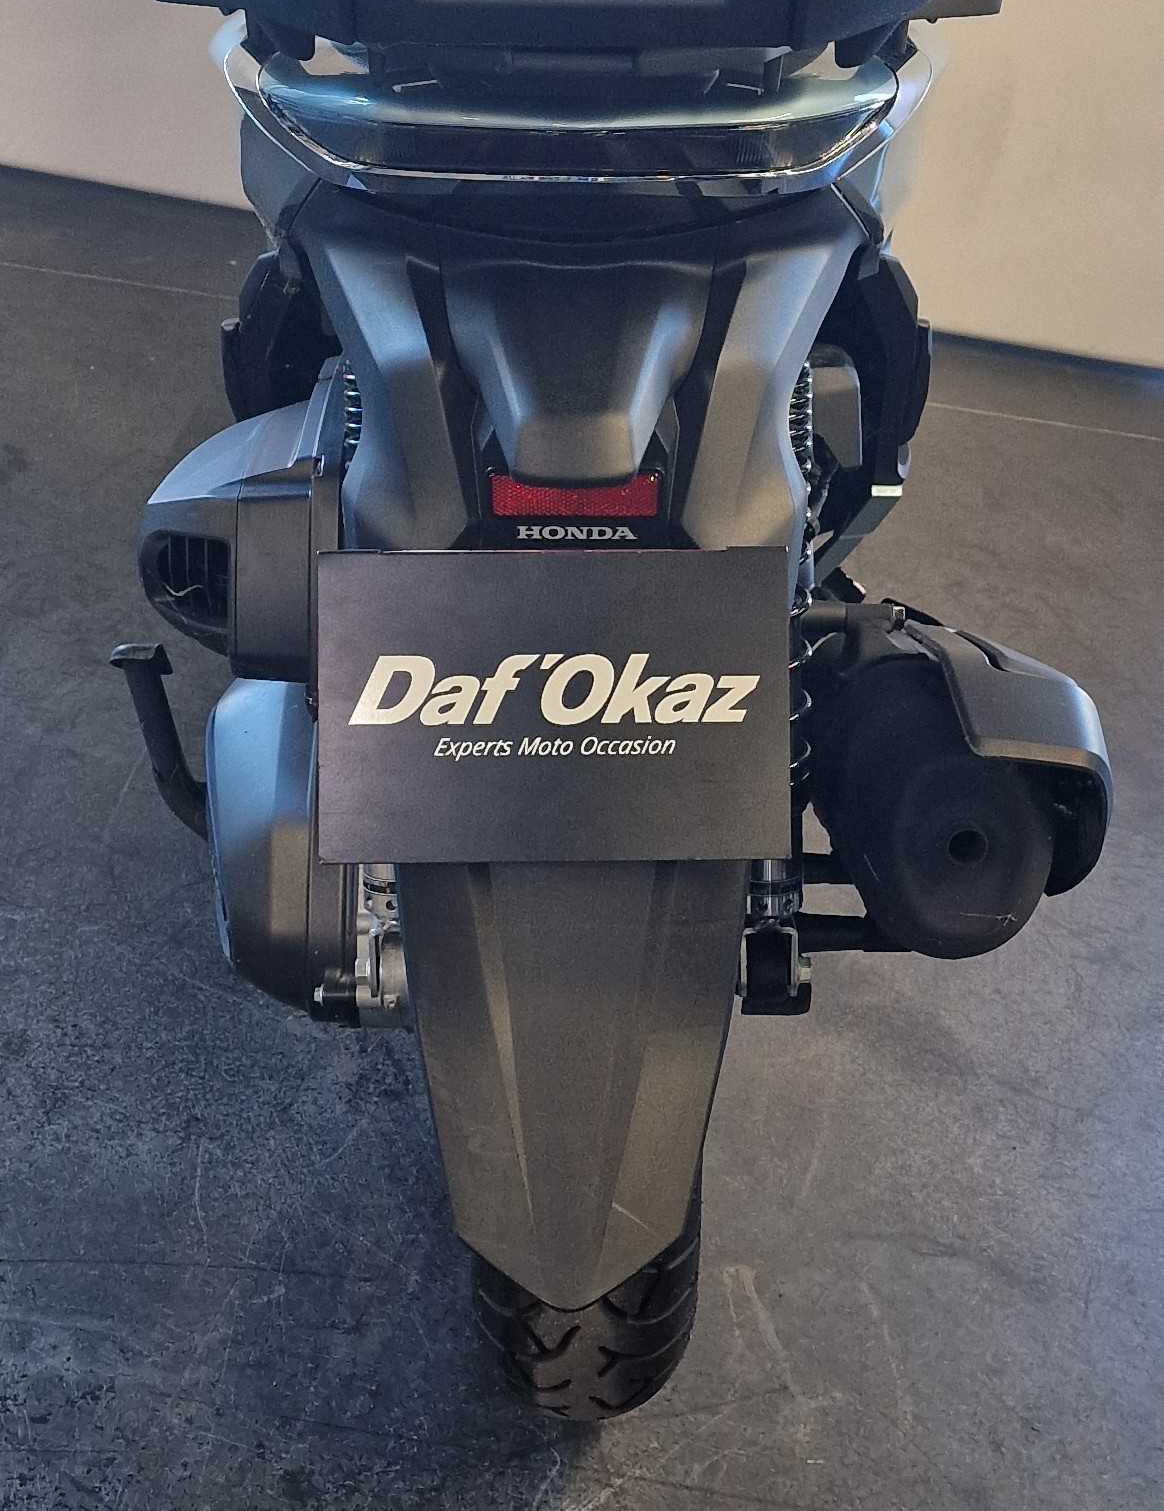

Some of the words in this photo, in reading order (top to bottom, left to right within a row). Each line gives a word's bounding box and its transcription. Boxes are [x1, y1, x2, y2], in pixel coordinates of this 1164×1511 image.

[517, 525, 637, 540] HONDA
[433, 736, 512, 760] Experts
[517, 737, 574, 756] Moto
[580, 735, 676, 755] Occasion
